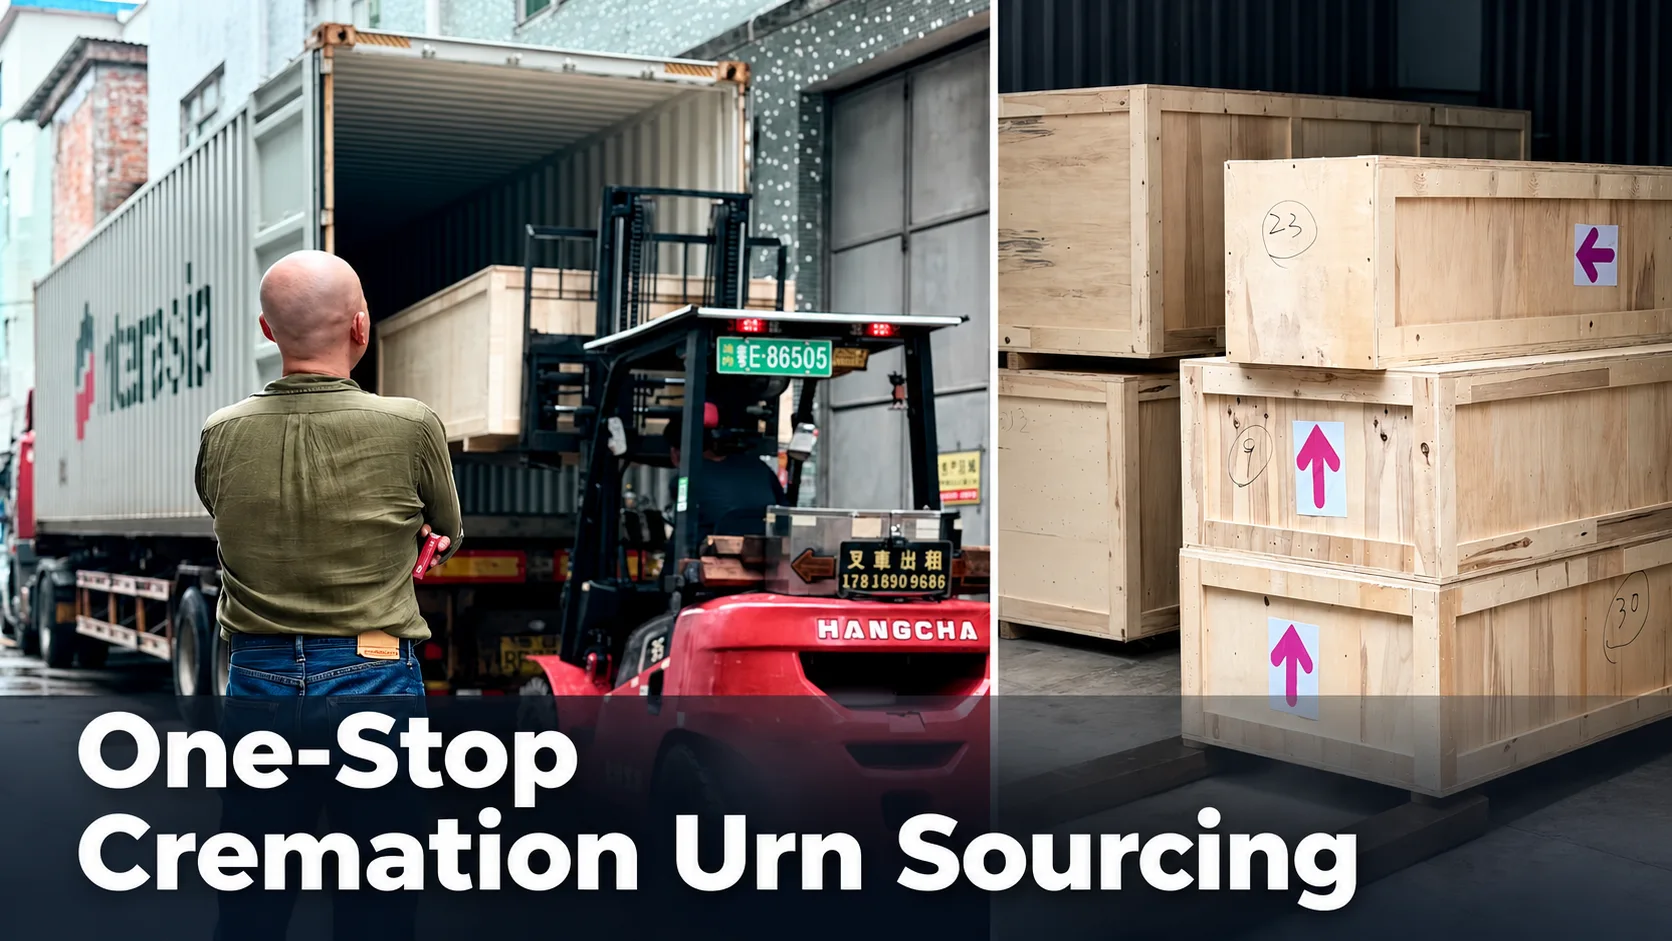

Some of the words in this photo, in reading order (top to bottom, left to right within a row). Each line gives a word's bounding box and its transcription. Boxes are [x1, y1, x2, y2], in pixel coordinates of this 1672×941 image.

[1269, 212, 1303, 239] 23
[1243, 437, 1256, 478] 9
[847, 549, 943, 571] 叉車出租
[842, 574, 869, 589] 178
[910, 574, 946, 589] 9686
[1616, 593, 1639, 629] 30
[817, 618, 978, 641] HANGCHA
